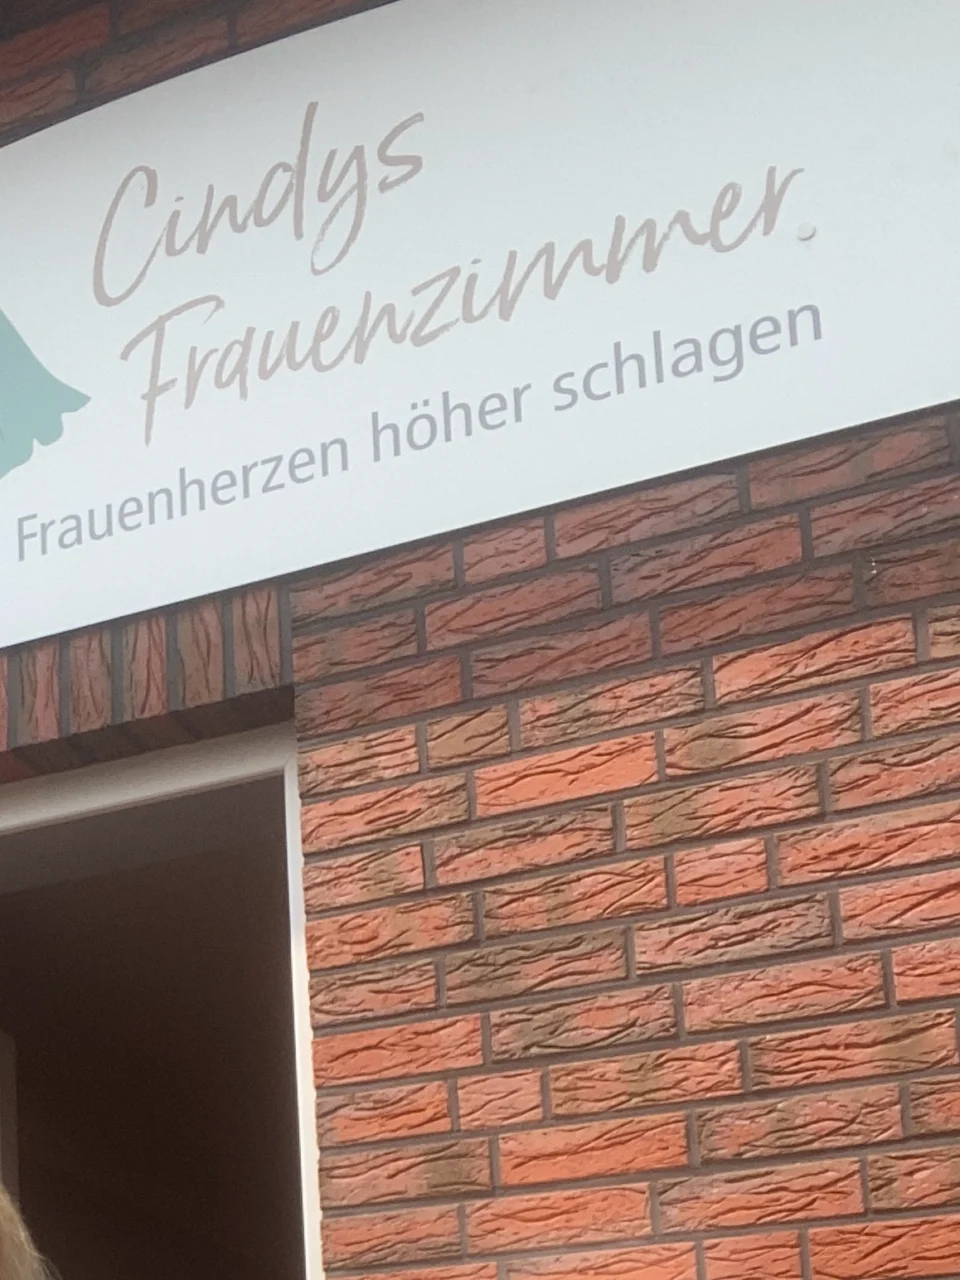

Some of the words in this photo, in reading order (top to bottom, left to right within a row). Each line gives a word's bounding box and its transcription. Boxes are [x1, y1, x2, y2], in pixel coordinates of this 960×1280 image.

[92, 100, 425, 308] Cindys
[119, 165, 805, 448] Frauenzimmer
[16, 436, 349, 563] Frauenherzen
[371, 382, 532, 463] höher
[553, 302, 823, 412] schlagen
